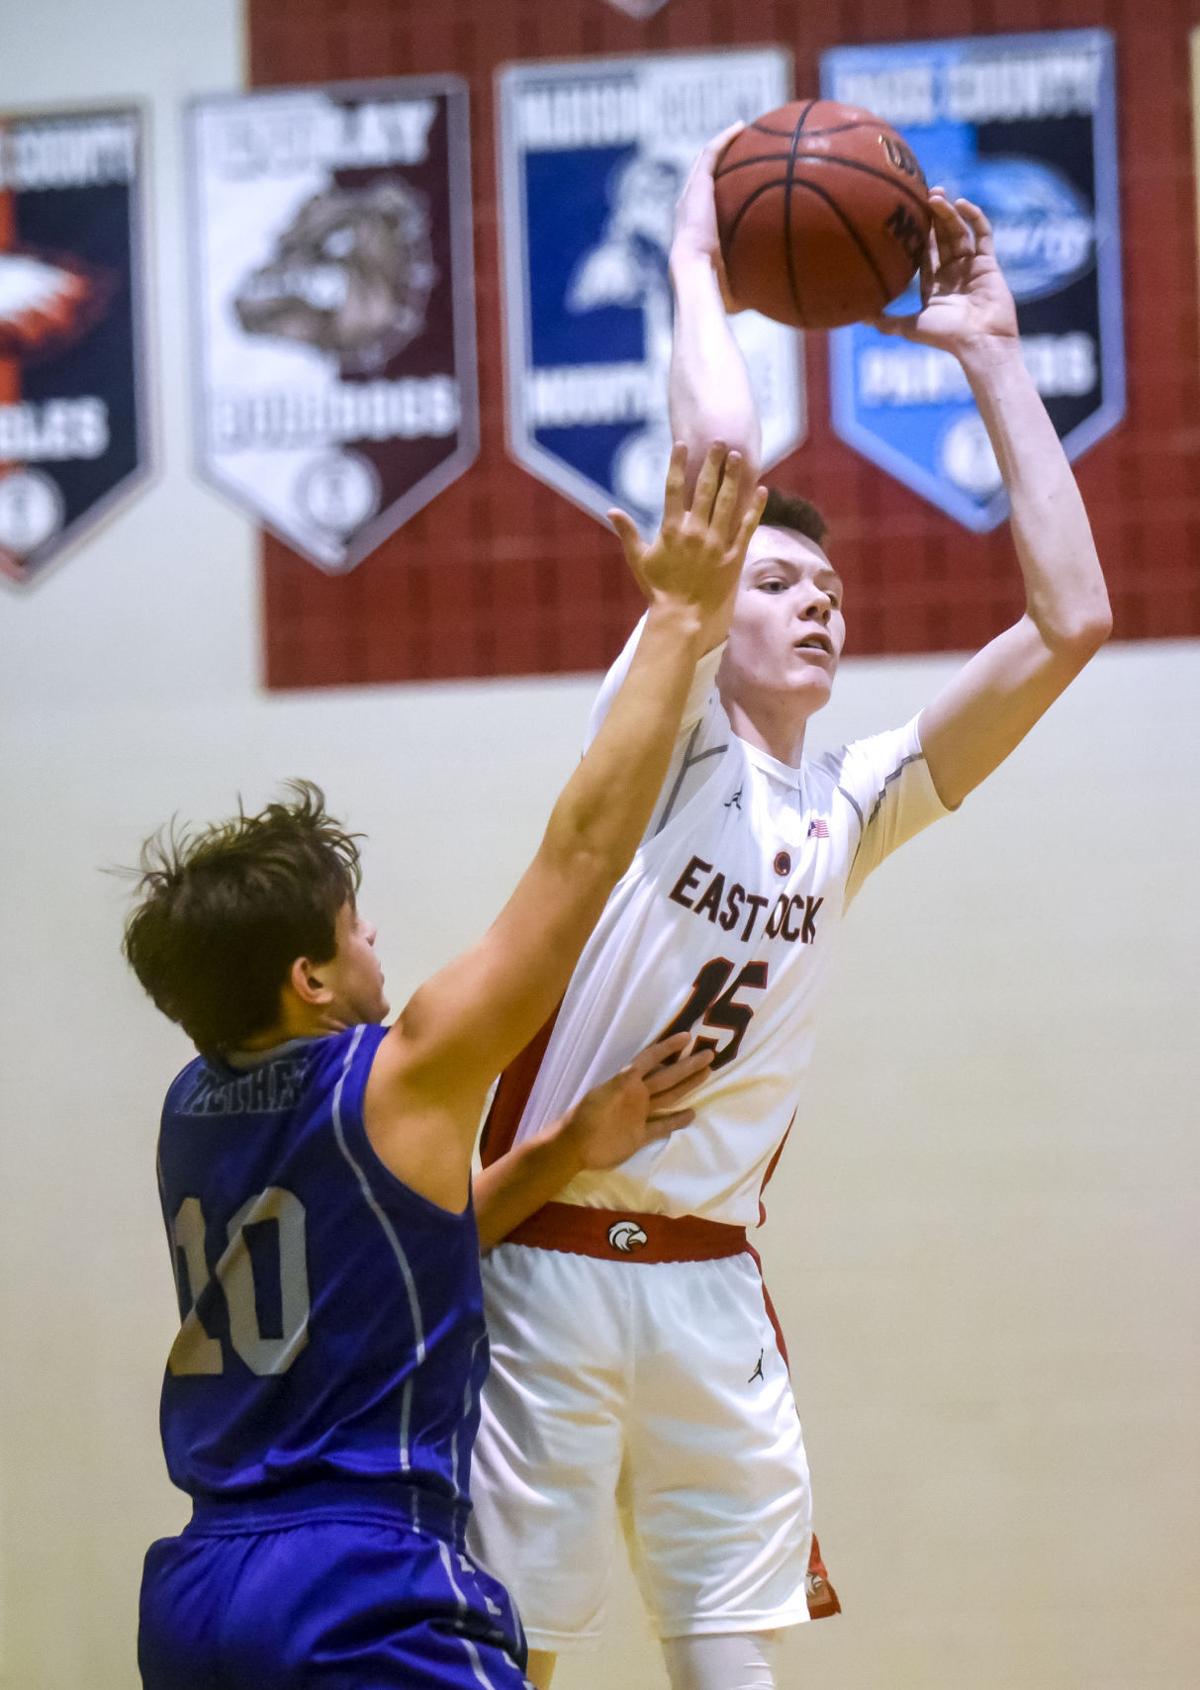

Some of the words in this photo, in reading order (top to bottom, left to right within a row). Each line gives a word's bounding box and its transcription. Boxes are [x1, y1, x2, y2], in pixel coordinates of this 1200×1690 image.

[668, 855, 769, 942] EAST
[765, 893, 824, 944] OCK
[655, 956, 769, 1072] 15
[166, 1186, 310, 1376] 10
